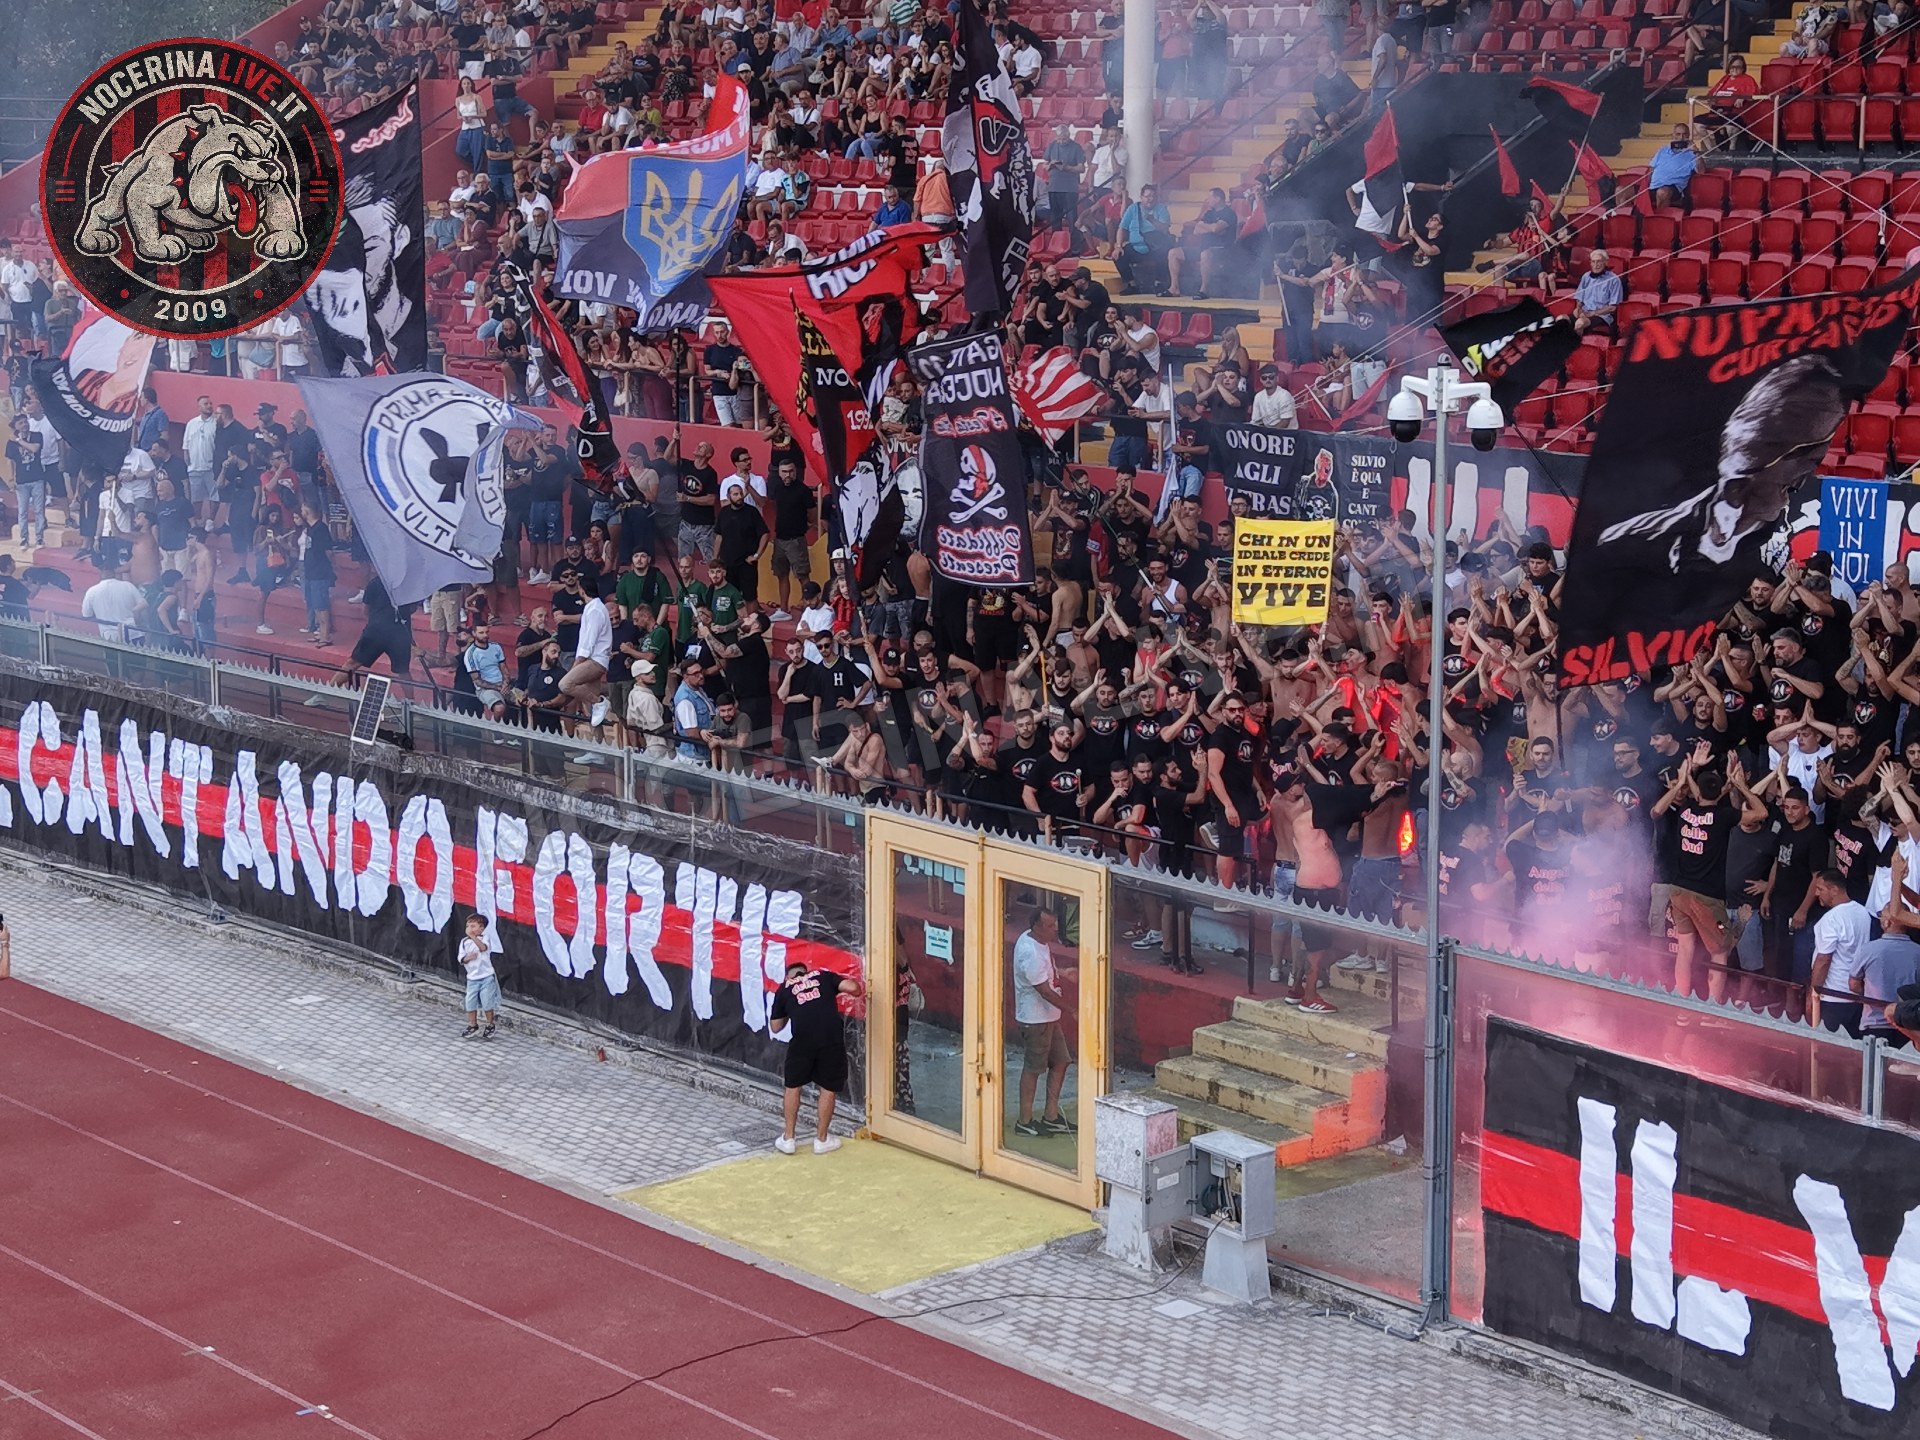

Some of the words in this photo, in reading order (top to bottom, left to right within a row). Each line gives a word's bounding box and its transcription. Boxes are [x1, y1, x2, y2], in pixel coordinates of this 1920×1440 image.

[1225, 429, 1296, 457] ONORE
[1351, 454, 1386, 469] SILVIO
[1234, 461, 1282, 485] AGLI
[1351, 469, 1359, 483] È
[1360, 471, 1381, 485] QUA
[1362, 488, 1370, 500] E
[1831, 486, 1878, 519] VIVI
[1348, 503, 1379, 516] CANT
[1238, 533, 1274, 547] CHI
[1278, 536, 1300, 548] IN
[1305, 535, 1331, 548] UN
[1839, 521, 1863, 549] IN
[1238, 550, 1287, 561] IDEALE
[1289, 551, 1330, 562] CREDE
[1237, 565, 1257, 577] IN
[1262, 565, 1330, 579] ETERNO
[1831, 550, 1870, 584] NOI
[1237, 582, 1326, 608] VIVE
[1560, 620, 1717, 688] SILVIO
[833, 672, 844, 686] H
[1681, 838, 1704, 855] Sud
[796, 987, 821, 1005] Sud
[1577, 1096, 1752, 1357] IL
[1793, 1172, 1920, 1412] V
